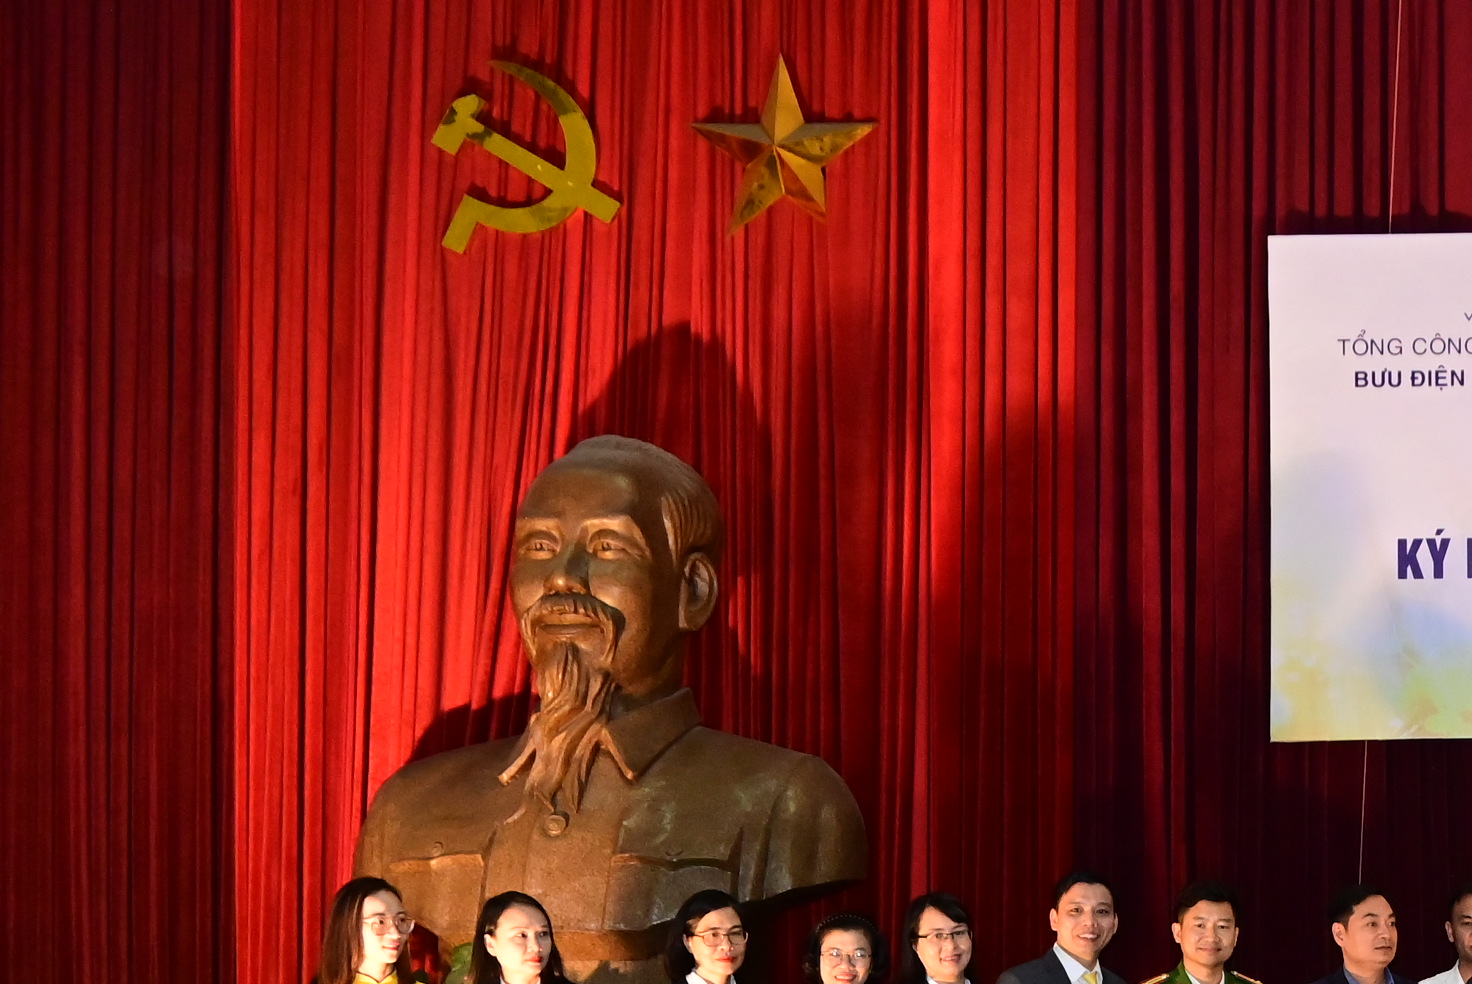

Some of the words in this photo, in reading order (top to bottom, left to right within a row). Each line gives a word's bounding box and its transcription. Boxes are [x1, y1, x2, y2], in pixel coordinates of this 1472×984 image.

[1337, 329, 1403, 356] TỔNG
[1354, 367, 1402, 388] BƯU
[1410, 364, 1466, 391] ĐIỆN
[1397, 528, 1451, 579] KÝ
